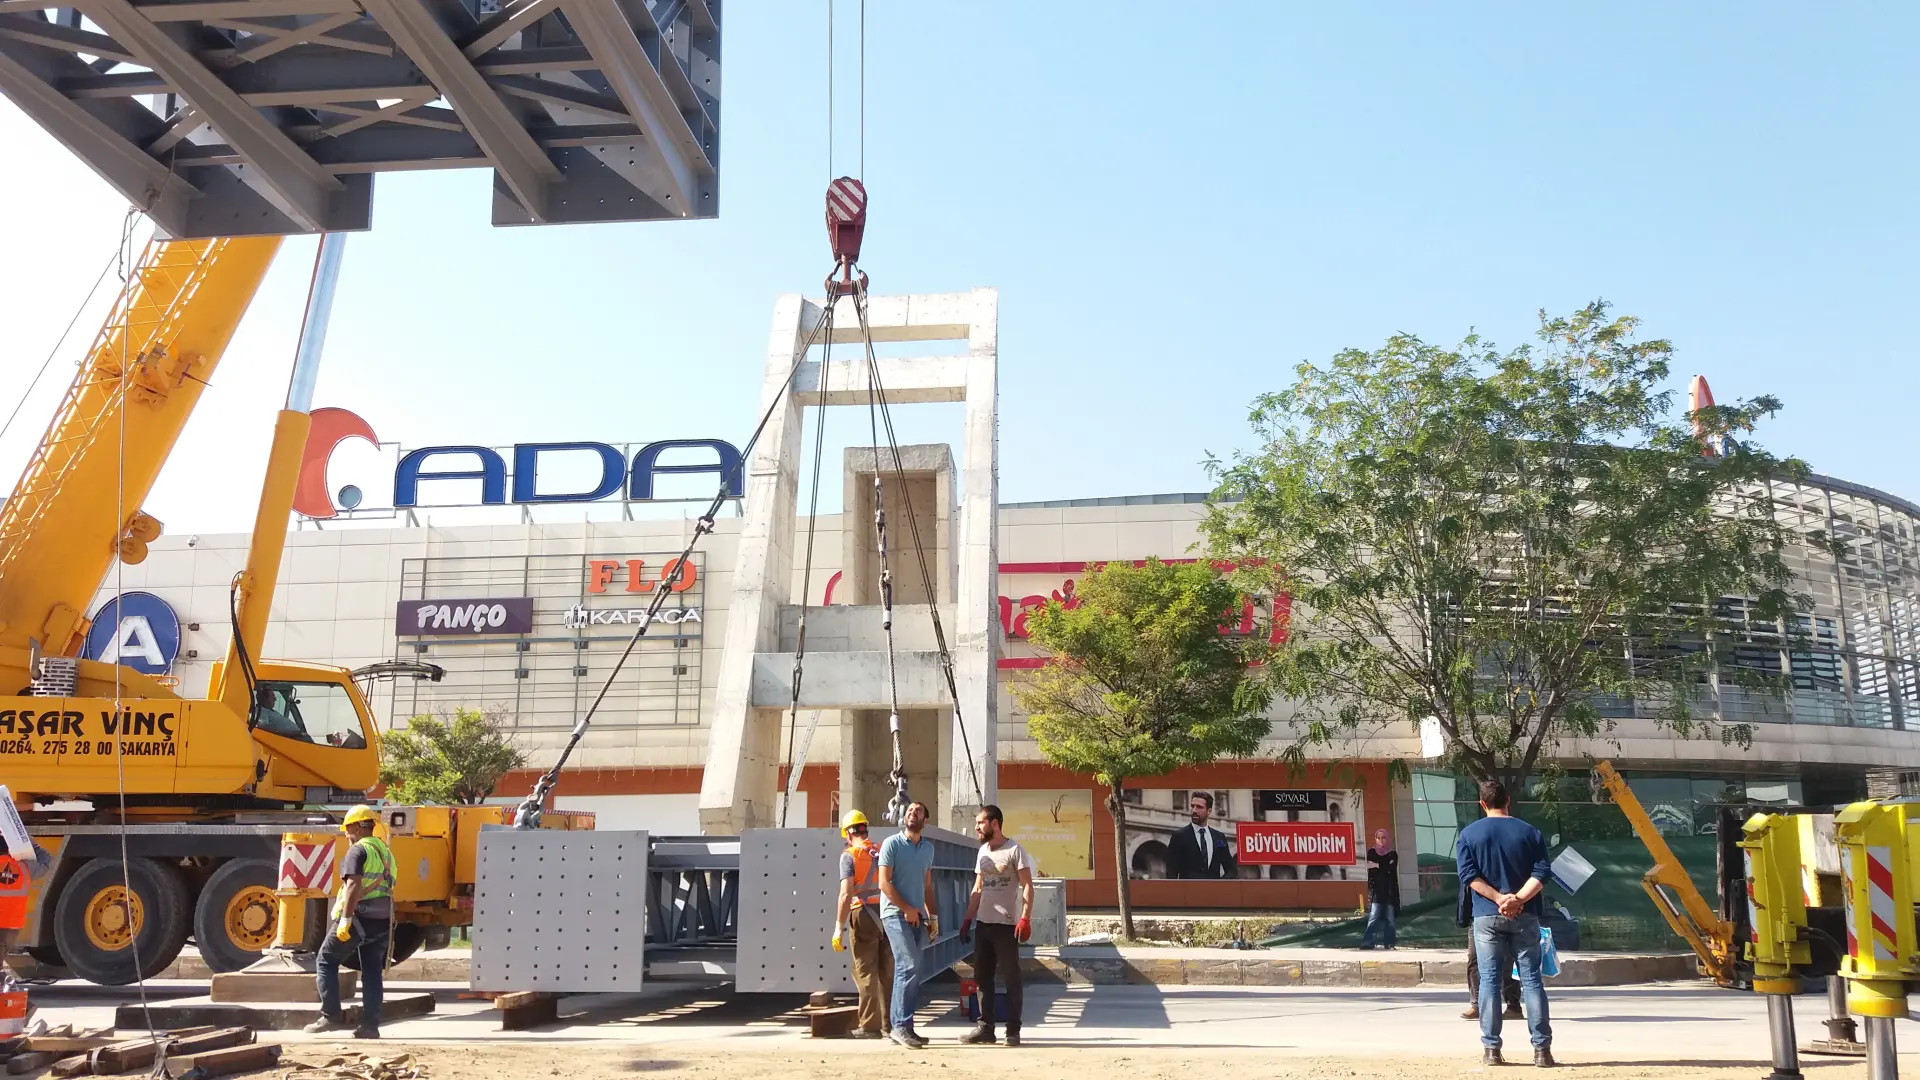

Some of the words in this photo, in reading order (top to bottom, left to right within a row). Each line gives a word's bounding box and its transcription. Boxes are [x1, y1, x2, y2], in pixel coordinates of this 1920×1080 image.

[393, 438, 745, 508] ADA
[587, 557, 698, 593] FLO
[417, 604, 507, 632] PANÇO
[590, 608, 702, 625] KARACA
[97, 615, 167, 666] A
[100, 706, 175, 742] VİNÇ
[43, 740, 68, 755] 275
[74, 741, 91, 755] 28
[97, 741, 113, 756] 00
[120, 741, 176, 757] SAKARYA
[1245, 832, 1291, 854] BÜYÜK
[1293, 832, 1347, 854] İNDİRİM
